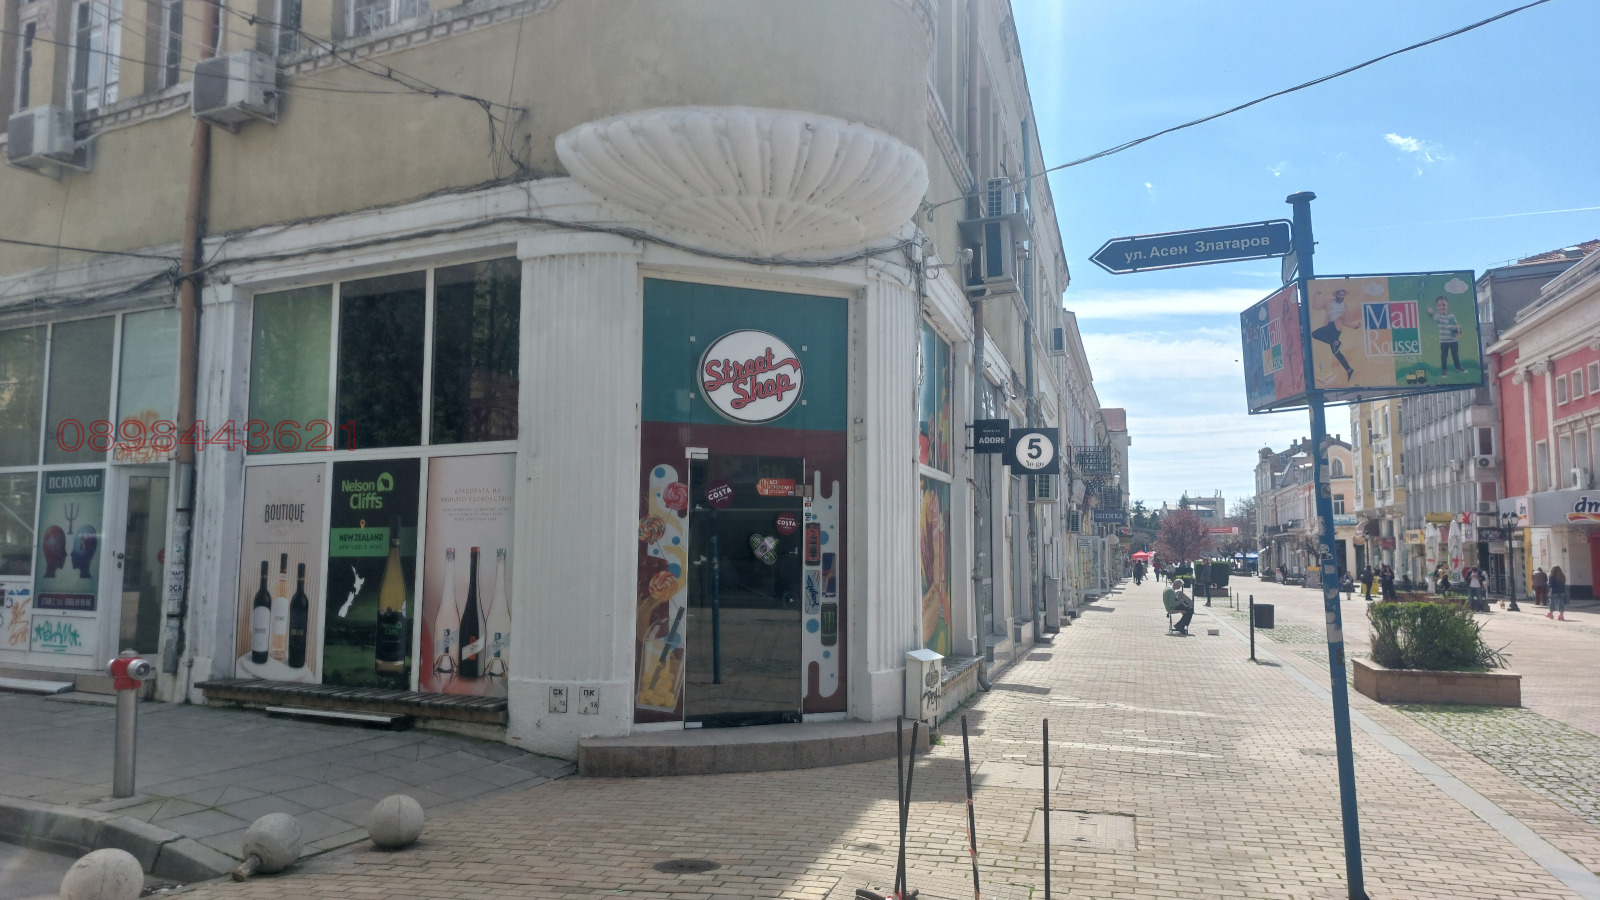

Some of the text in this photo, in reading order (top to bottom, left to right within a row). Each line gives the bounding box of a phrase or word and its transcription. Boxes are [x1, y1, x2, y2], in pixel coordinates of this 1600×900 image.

[1124, 236, 1270, 264] ул. Асен Златаров
[1366, 302, 1417, 329] Mall
[1261, 320, 1281, 351] Mall
[1366, 329, 1419, 354] Rousse
[704, 347, 800, 391] Street
[731, 373, 796, 409] Shop
[979, 436, 1006, 444] ADORE
[1027, 438, 1042, 459] 5
[48, 474, 100, 489] ПСИХОЛОГ
[341, 479, 375, 492] Nelson
[349, 492, 383, 509] Cliffs
[708, 487, 733, 501] COSTA
[264, 503, 305, 523] BOUTIQUE
[777, 519, 796, 527] COSTA
[355, 533, 384, 541] ZEALAND
